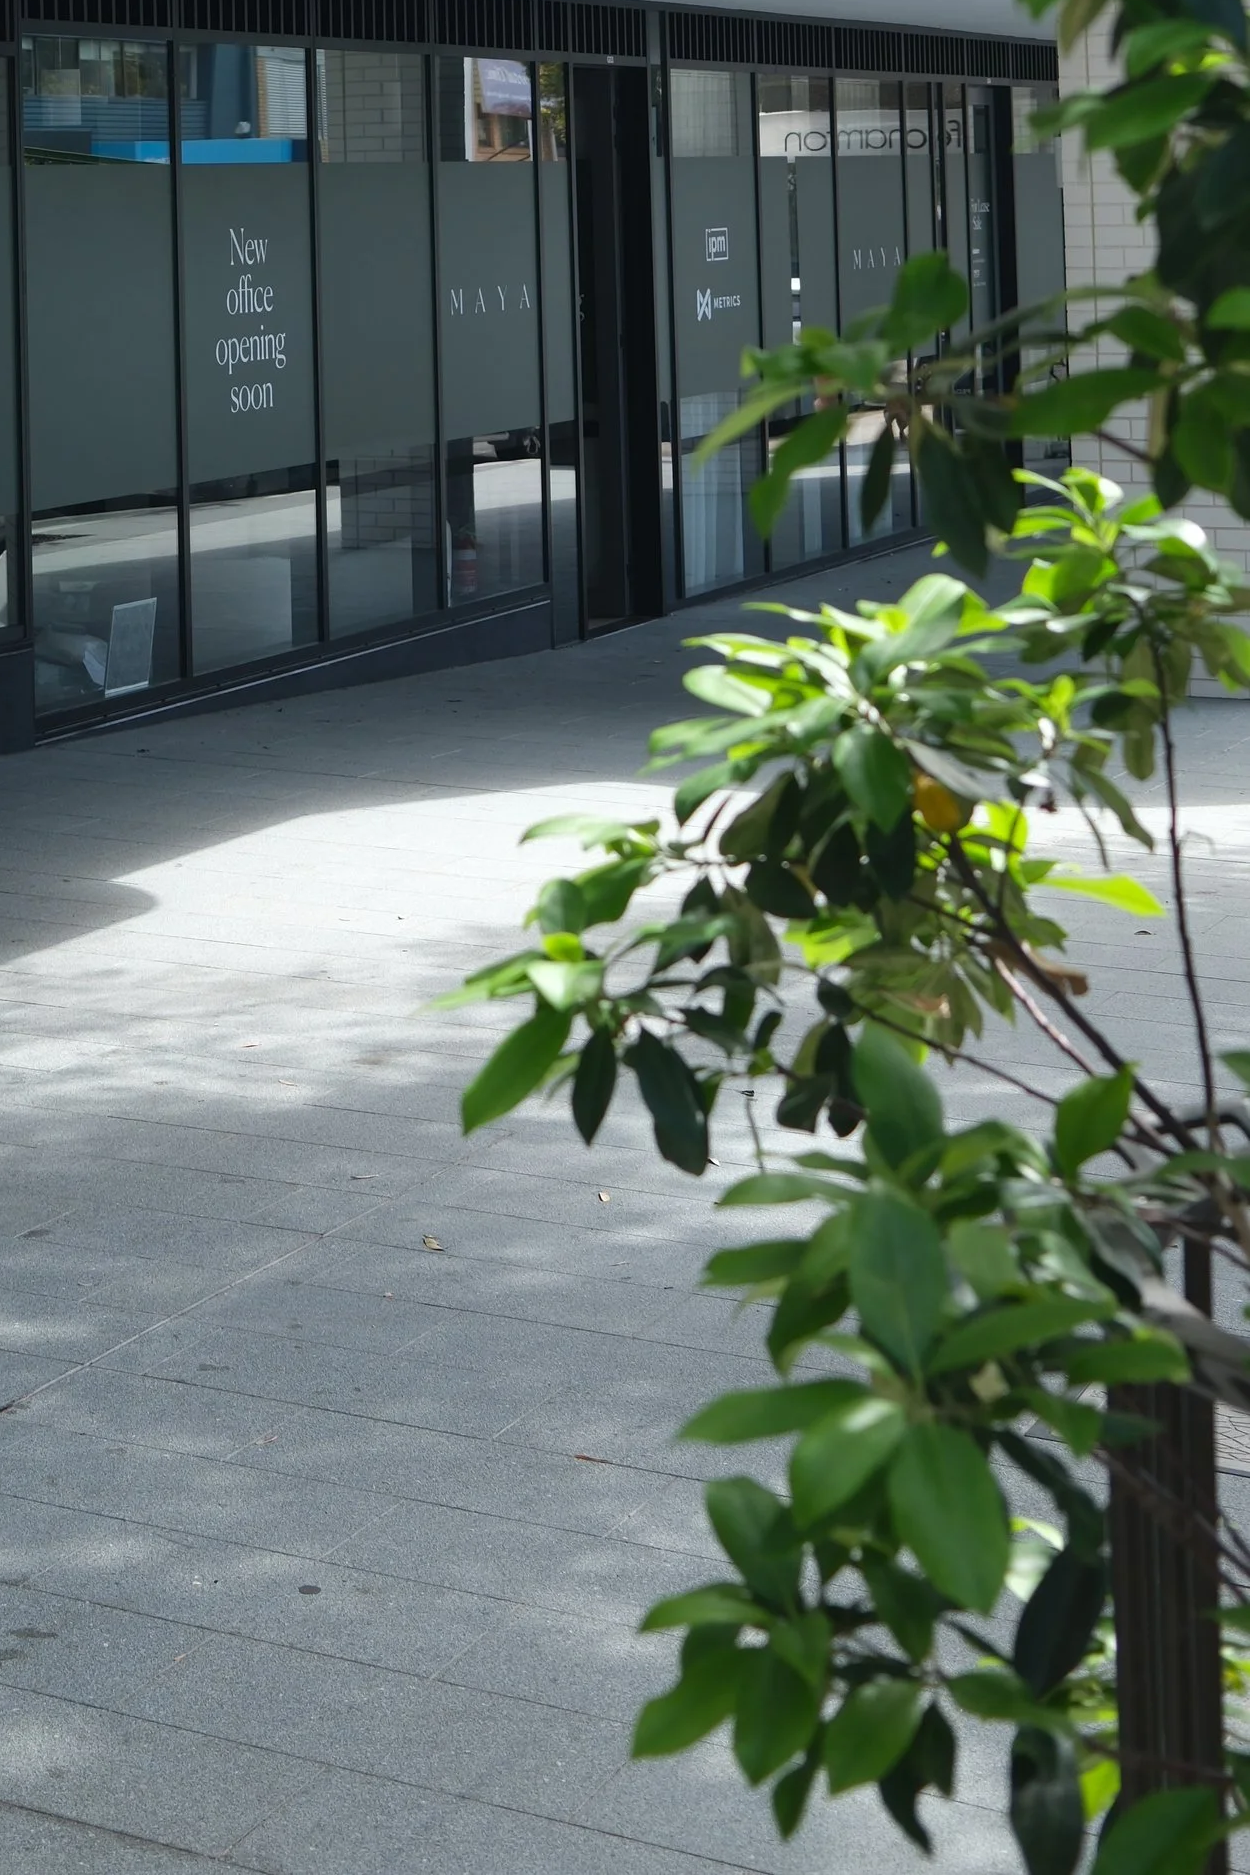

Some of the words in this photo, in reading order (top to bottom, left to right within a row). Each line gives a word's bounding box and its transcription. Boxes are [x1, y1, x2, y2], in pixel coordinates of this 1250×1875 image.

[229, 227, 268, 267] New
[707, 229, 727, 261] ipm
[853, 246, 901, 270] MAYA
[226, 274, 274, 316] office
[450, 284, 531, 316] MAYA
[713, 295, 741, 310] METRICS
[215, 325, 287, 375] opening
[229, 379, 274, 414] soon
